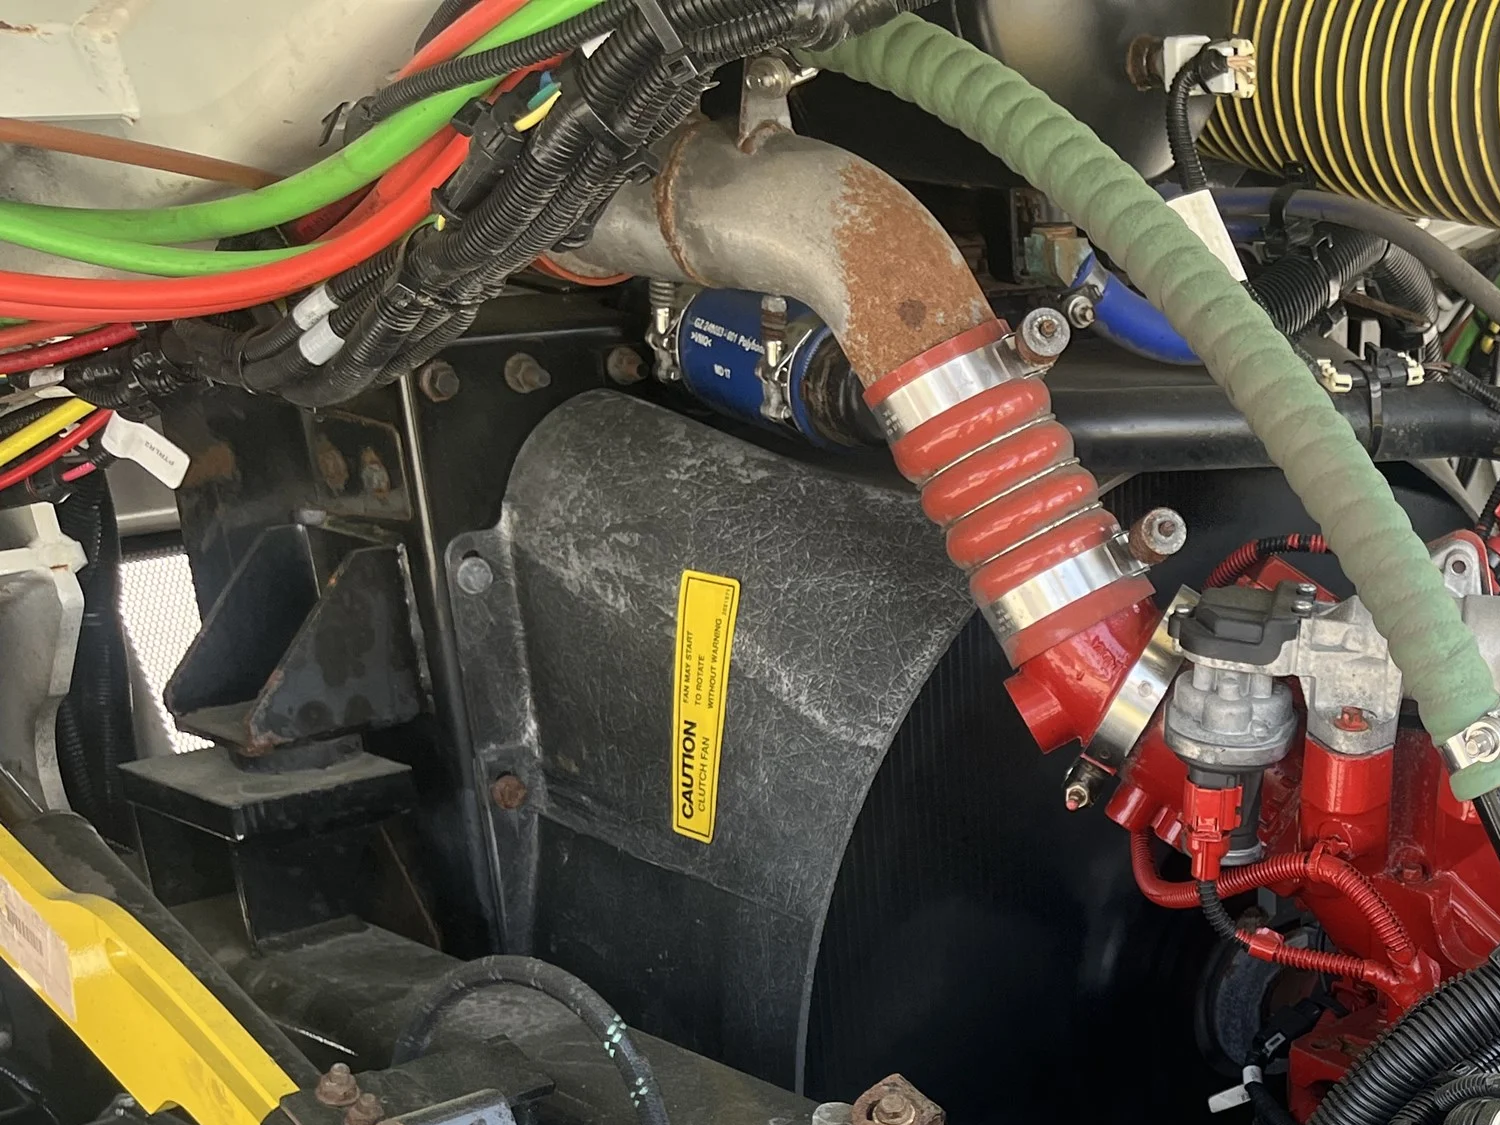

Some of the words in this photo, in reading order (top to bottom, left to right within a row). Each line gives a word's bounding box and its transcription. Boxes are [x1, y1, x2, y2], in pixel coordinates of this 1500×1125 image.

[685, 630, 694, 661] START
[711, 618, 723, 663] WARNING
[684, 662, 692, 684] MAY
[696, 655, 705, 691] ROTATE
[707, 665, 717, 709] WITHOUT
[695, 691, 702, 706] TO
[700, 736, 710, 760] FAN
[681, 719, 697, 820] CAUTION
[698, 763, 708, 812] CLUTCH
